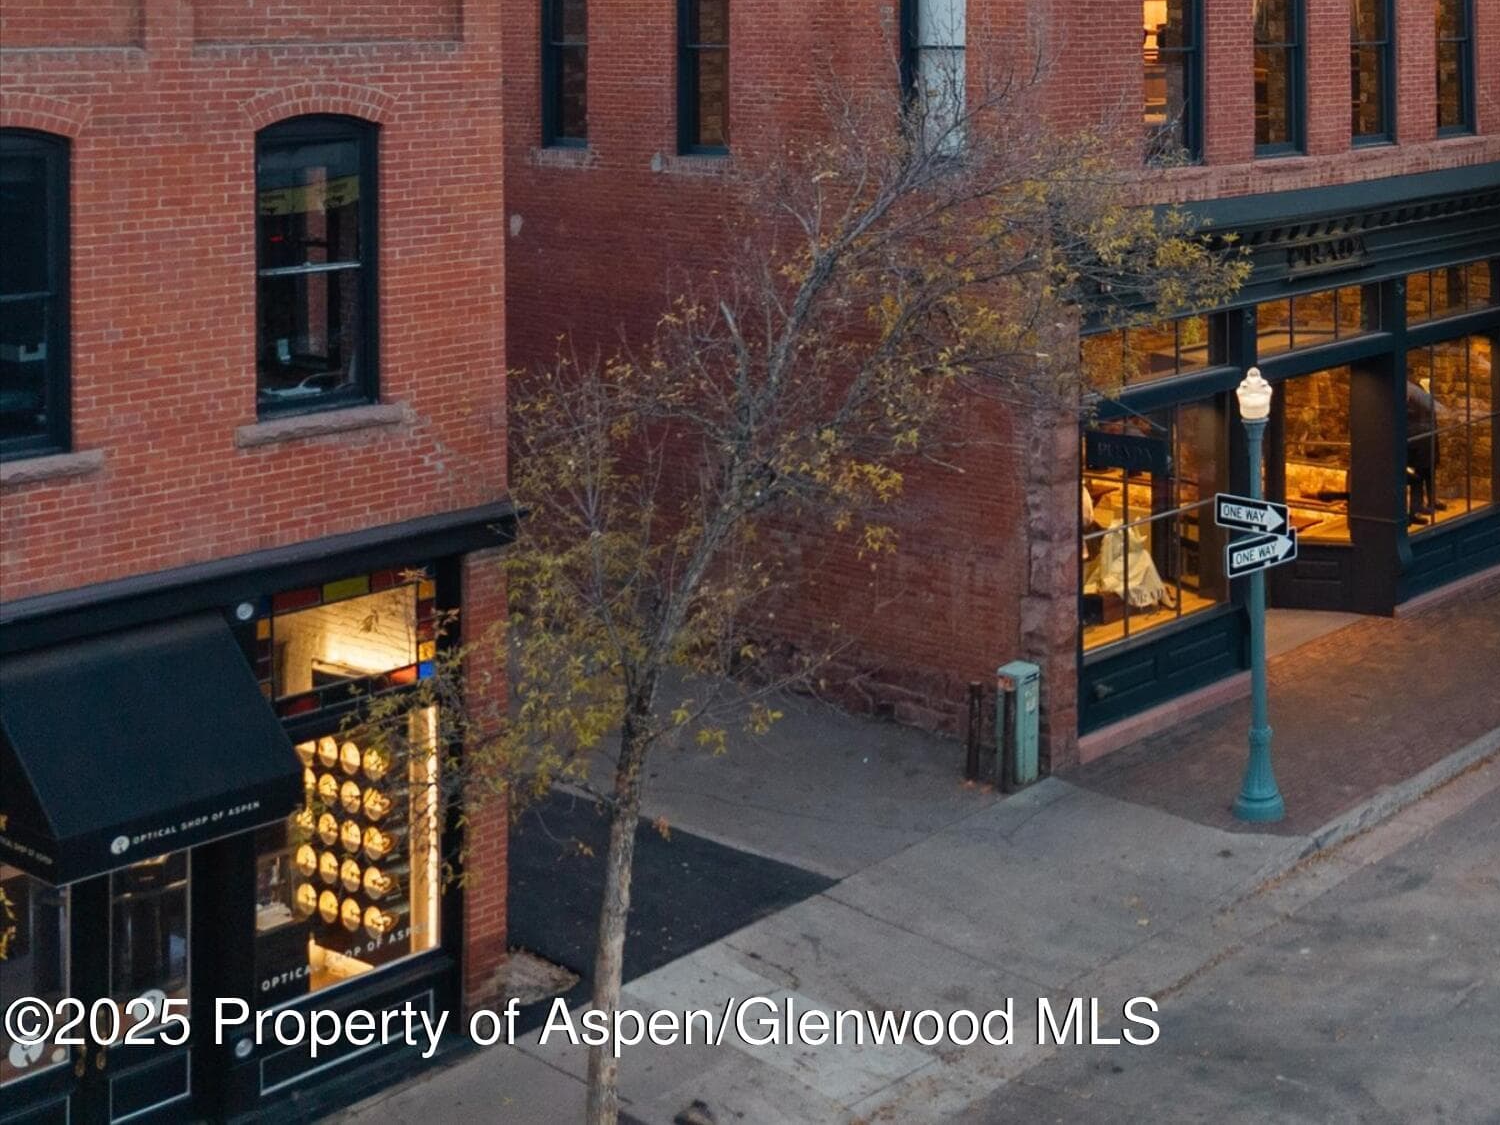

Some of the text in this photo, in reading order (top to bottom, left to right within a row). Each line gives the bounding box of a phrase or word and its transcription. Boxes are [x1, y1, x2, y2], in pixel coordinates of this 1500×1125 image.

[1286, 235, 1369, 268] PRADA
[1222, 505, 1266, 522] ONE WAY
[1235, 543, 1277, 565] ONE WAY
[132, 800, 261, 845] OPTICAL SHOP OF ASPEN
[261, 964, 319, 991] OPTICA
[367, 939, 383, 952] OF
